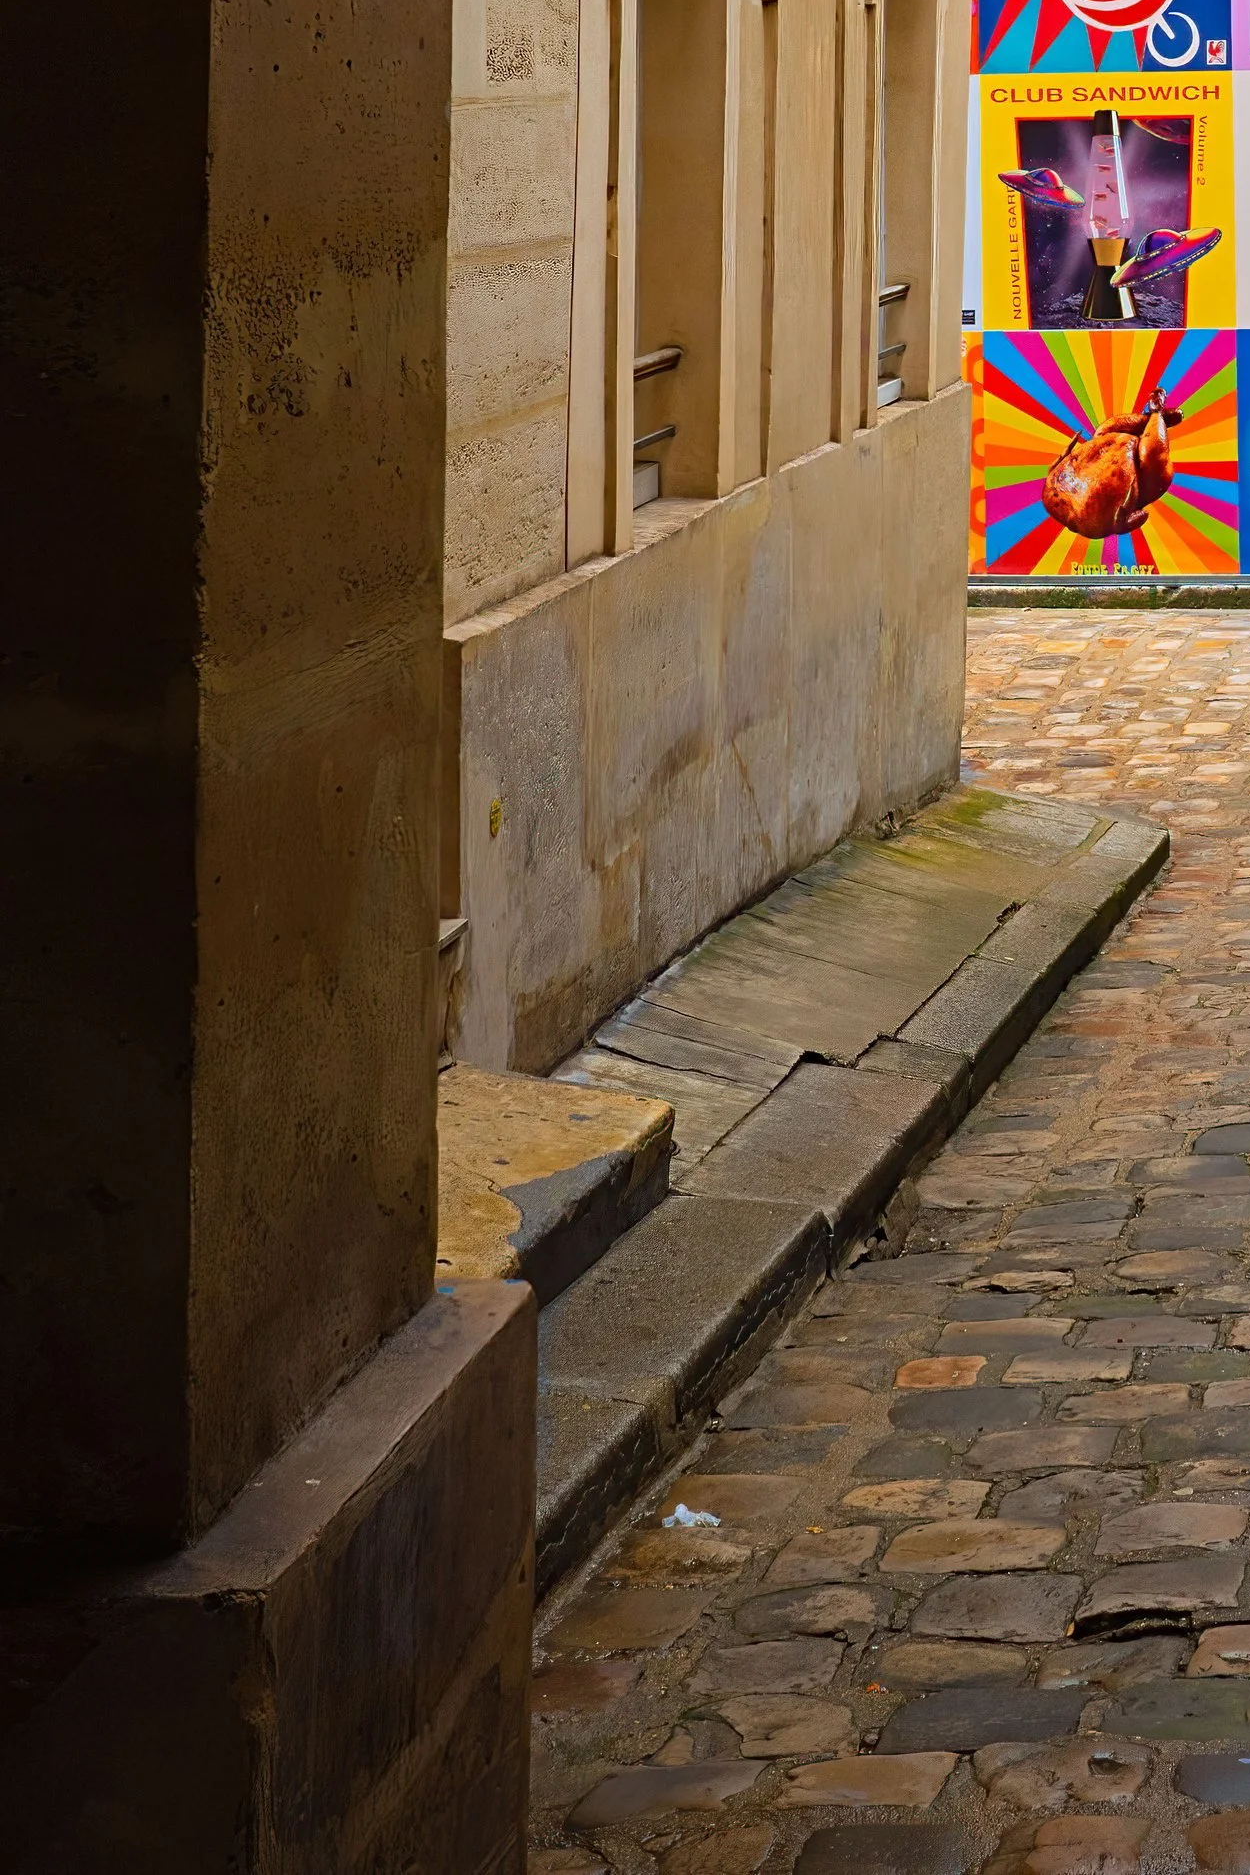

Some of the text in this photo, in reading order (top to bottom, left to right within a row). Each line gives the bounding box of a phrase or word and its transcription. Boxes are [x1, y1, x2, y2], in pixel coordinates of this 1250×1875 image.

[990, 85, 1220, 103] CLUB SANDWICH
[1196, 115, 1208, 186] Volume 2
[1008, 236, 1022, 320] NOUVELLE
